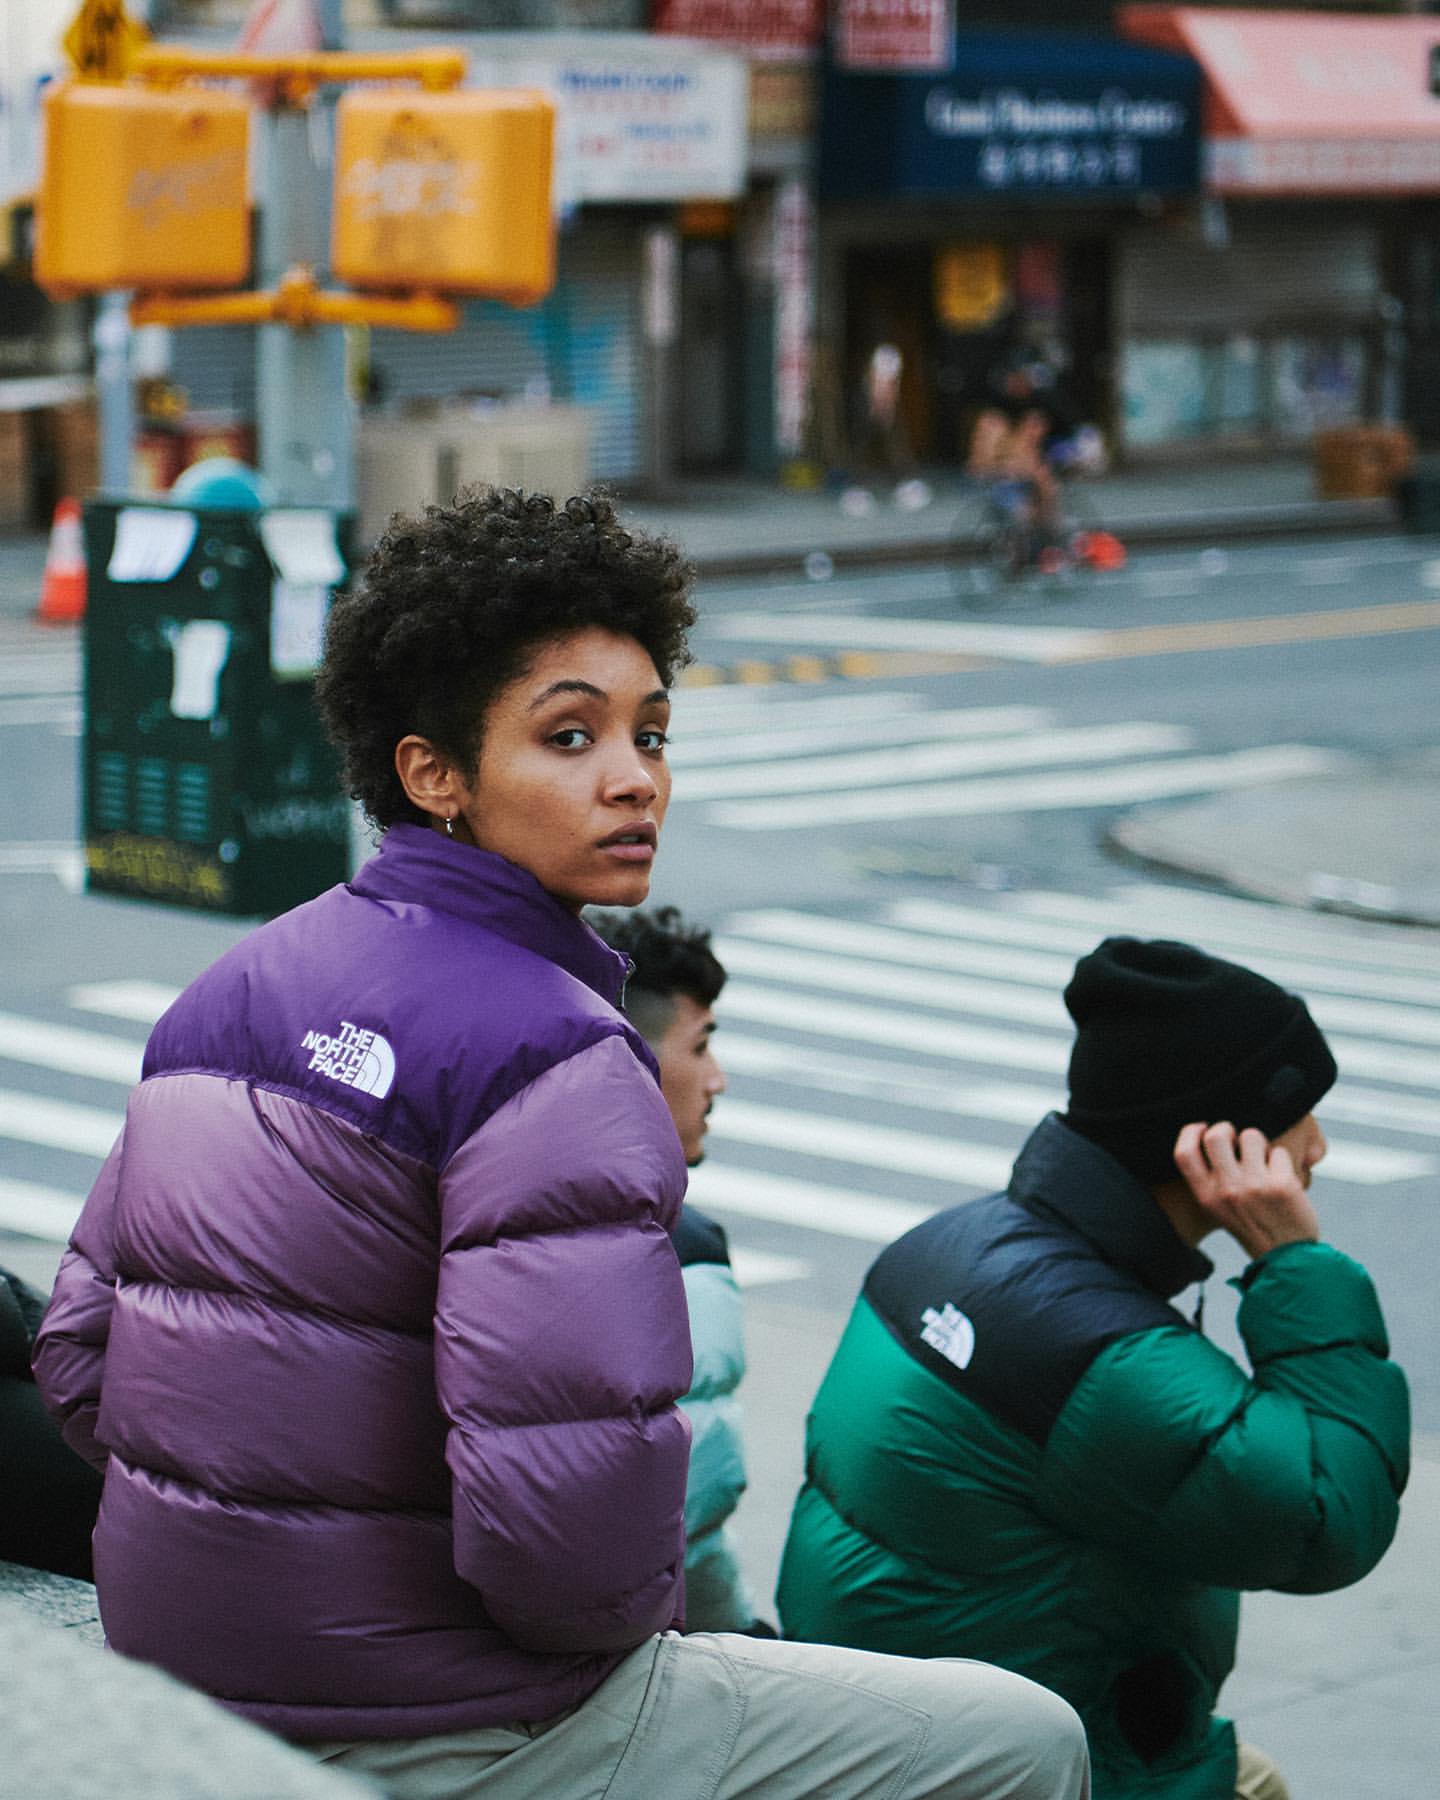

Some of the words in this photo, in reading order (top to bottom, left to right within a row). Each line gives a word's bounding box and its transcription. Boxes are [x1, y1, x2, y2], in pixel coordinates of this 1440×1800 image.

[300, 1029, 368, 1068] NORTH
[339, 1021, 375, 1050] THE
[307, 1052, 359, 1085] FACE
